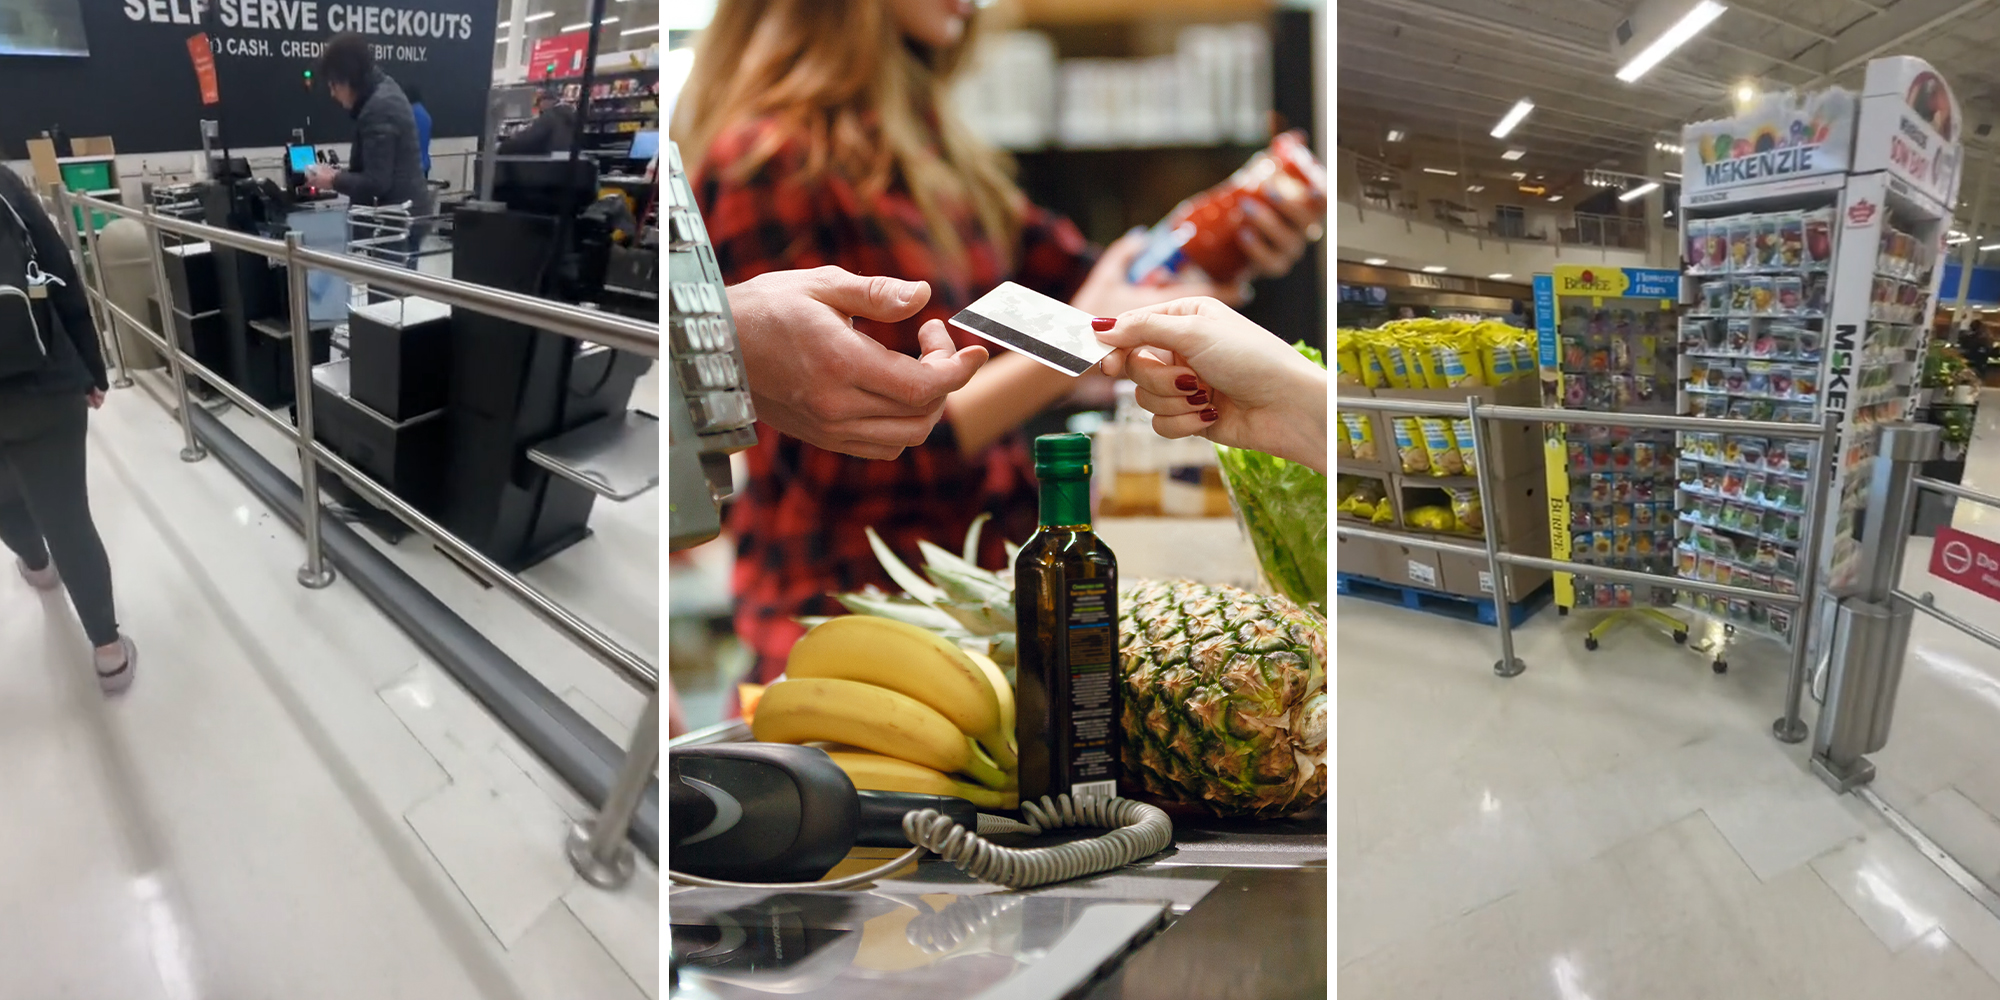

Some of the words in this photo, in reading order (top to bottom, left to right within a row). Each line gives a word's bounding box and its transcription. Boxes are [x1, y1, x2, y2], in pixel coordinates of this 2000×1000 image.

[220, 0, 318, 31] SERVE
[327, 3, 472, 40] CHECKOUTS
[1976, 552, 1998, 571] Do
